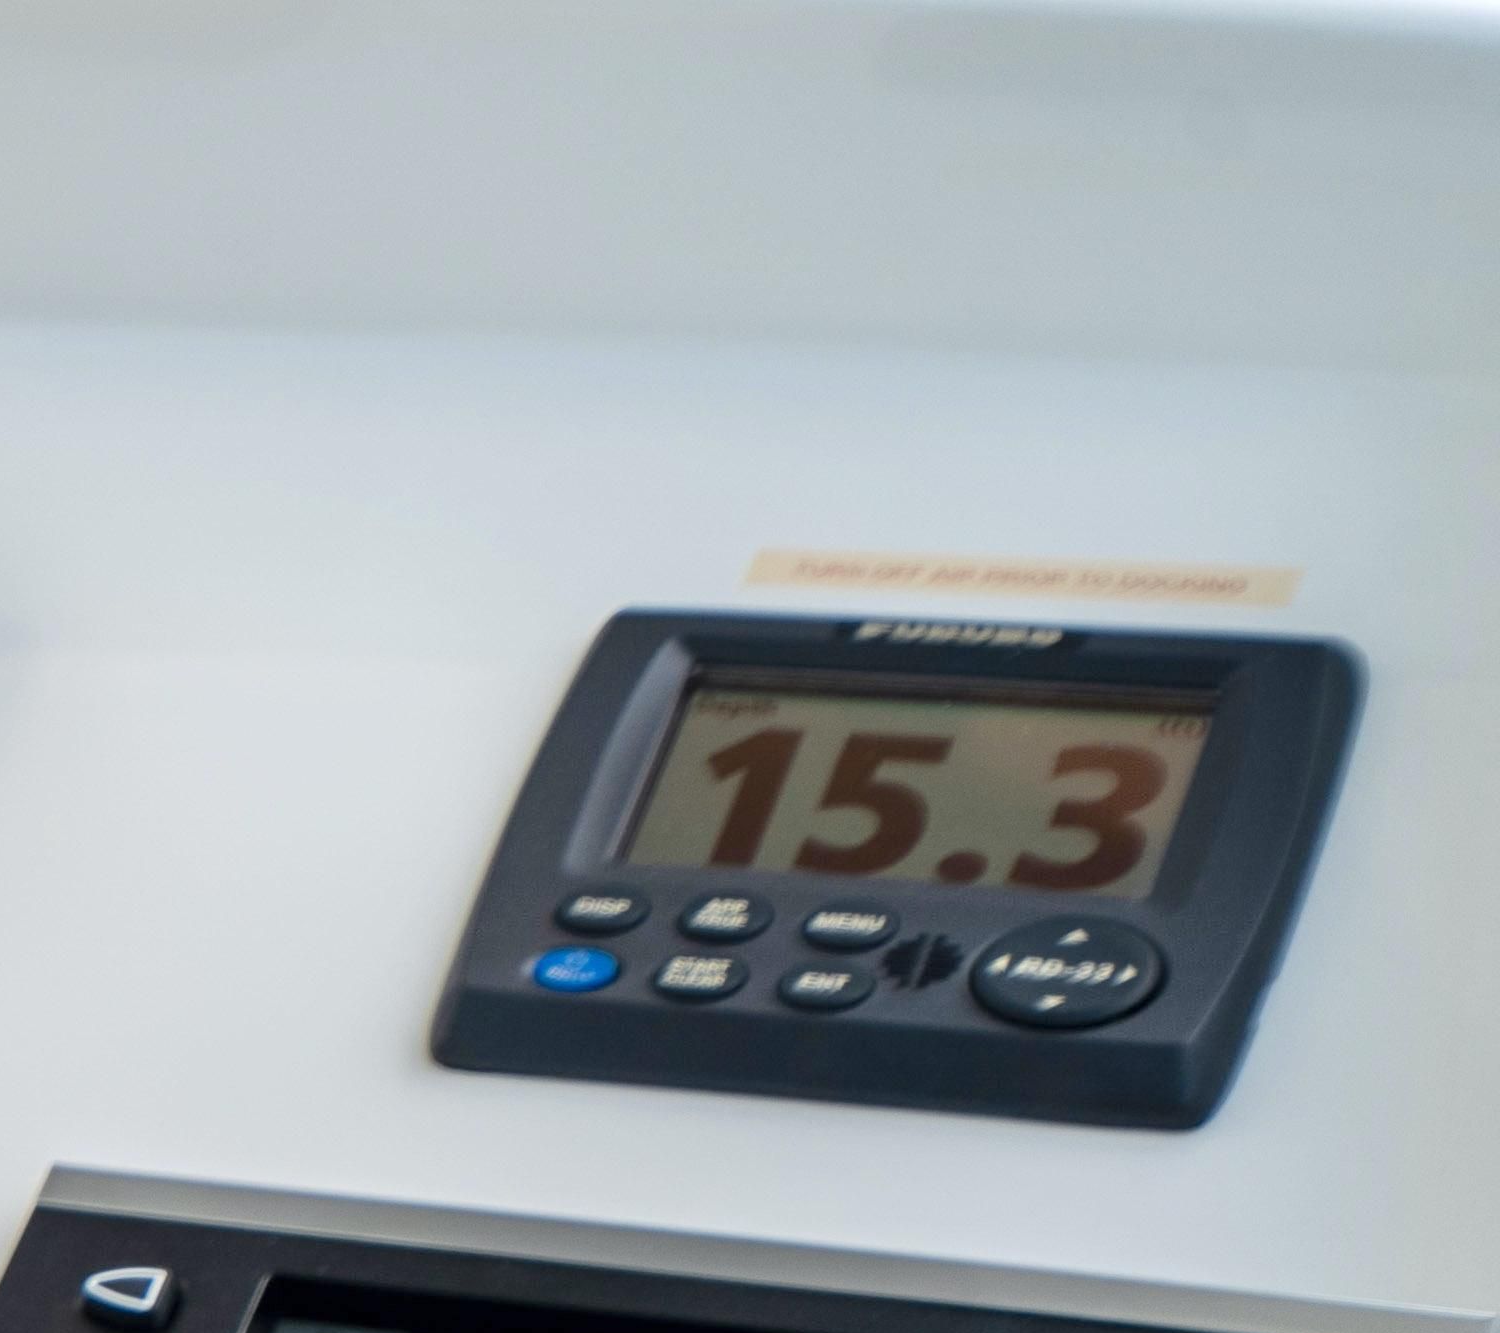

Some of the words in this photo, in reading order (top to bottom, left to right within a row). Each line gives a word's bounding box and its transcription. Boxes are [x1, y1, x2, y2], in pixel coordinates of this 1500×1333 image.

[854, 621, 1065, 648] FURUNO
[705, 726, 1170, 892] 15.3
[567, 896, 633, 918] DISP
[807, 911, 886, 935] MENU
[791, 971, 852, 993] ENT
